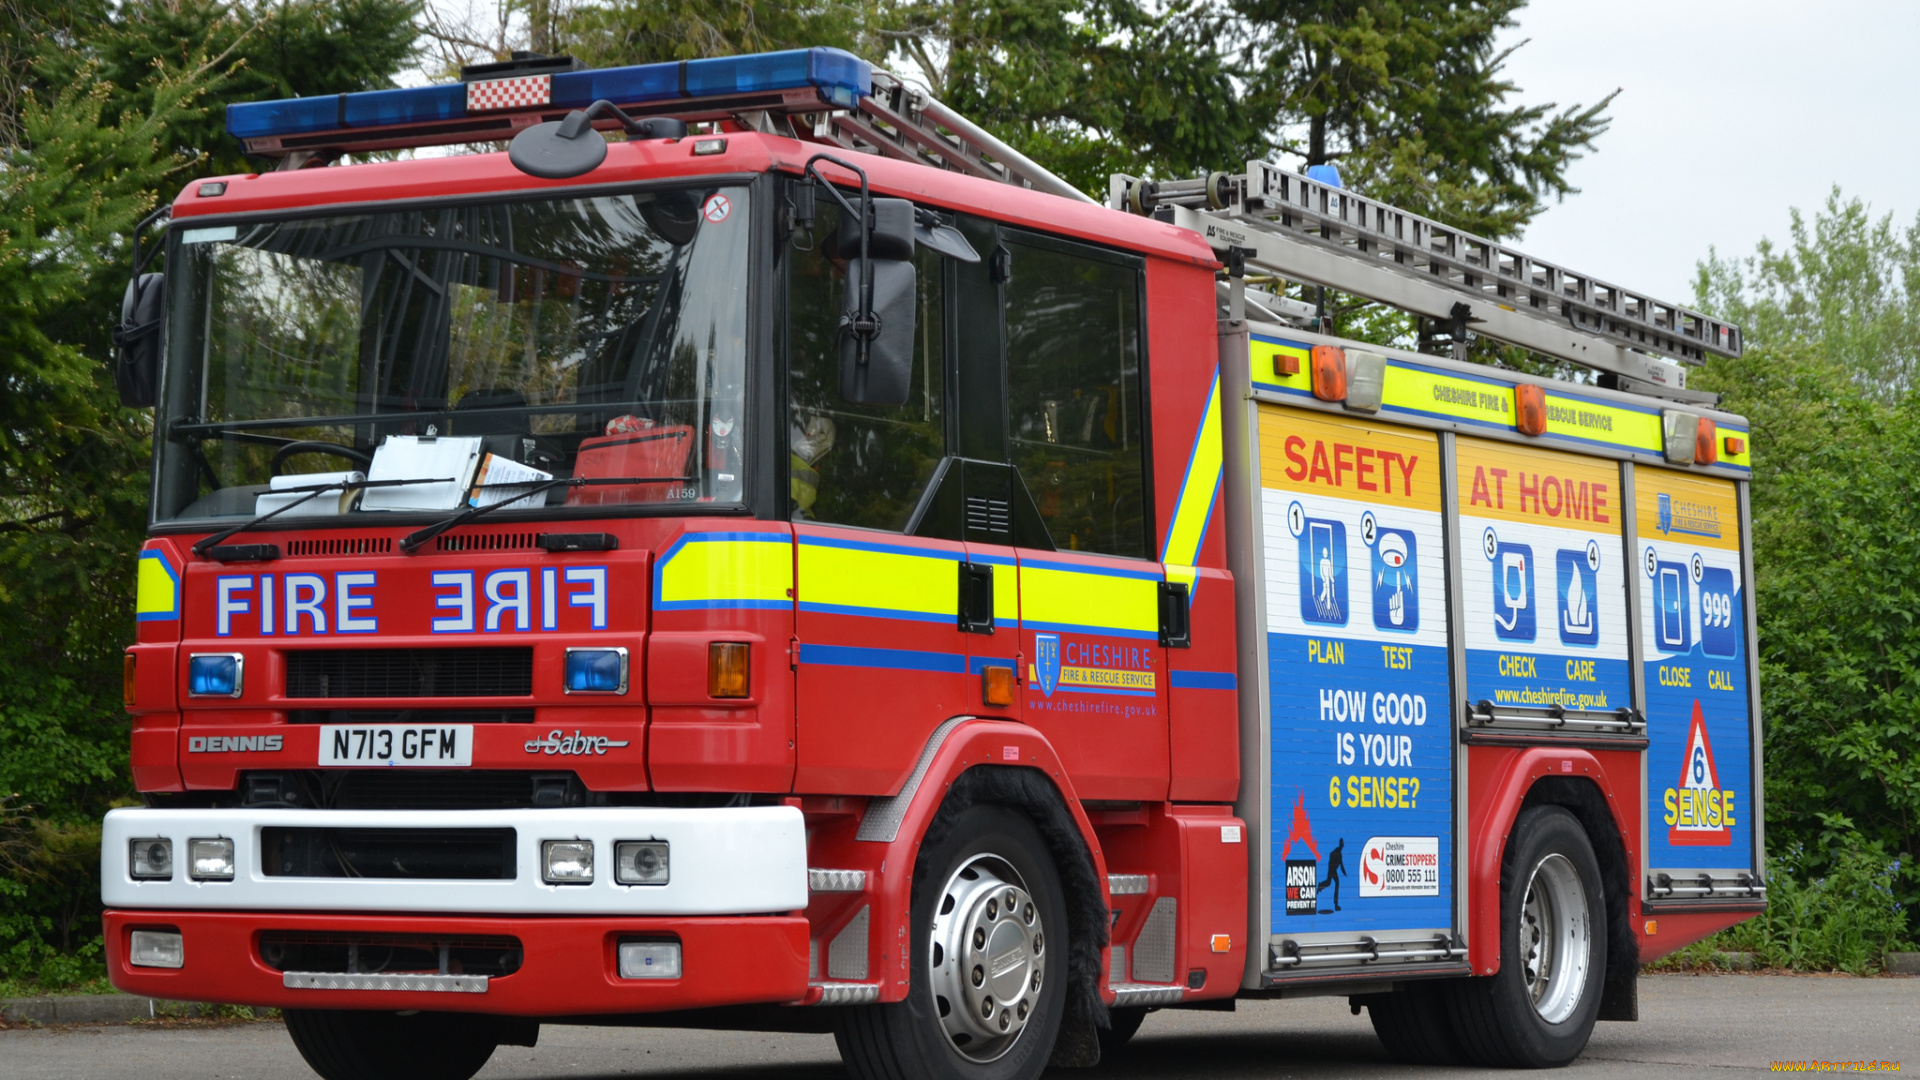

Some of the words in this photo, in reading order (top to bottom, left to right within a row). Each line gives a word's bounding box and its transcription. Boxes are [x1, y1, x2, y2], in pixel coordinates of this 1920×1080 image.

[1220, 234, 1243, 246] EQUIPMENT
[1433, 384, 1477, 408] CHESHIRE
[1479, 394, 1499, 410] FIRE
[1501, 397, 1508, 413] &
[1545, 405, 1576, 425] RESCUE
[1578, 411, 1612, 431] SERVICE
[1284, 435, 1418, 497] SAFETY
[667, 488, 696, 499] A159
[1470, 465, 1508, 509] AT
[1519, 472, 1610, 524] HOME
[1293, 509, 1299, 530] 1
[1673, 500, 1718, 520] CHESHIRE
[1365, 518, 1373, 539] 2
[1674, 517, 1683, 526] FIRE
[1688, 519, 1703, 529] RESCUE
[1703, 522, 1719, 531] SERVICE
[1487, 534, 1494, 554] 3
[1589, 546, 1596, 566] 4
[1648, 553, 1655, 572] 5
[1694, 559, 1700, 578] 6
[217, 570, 378, 637] FIRE
[1703, 591, 1731, 629] 999
[1066, 642, 1150, 669] CHESHIRE
[1308, 639, 1344, 664] PLAN
[1381, 645, 1413, 670] TEST
[1499, 654, 1537, 678] CHECK
[1566, 659, 1596, 682] CARE
[1659, 665, 1691, 687] CLOSE
[1063, 669, 1079, 681] FIRE
[1082, 672, 1088, 682] &
[1090, 671, 1120, 684] RESCUE
[1121, 673, 1153, 686] SERVICE
[1708, 669, 1734, 691] CALL
[1029, 699, 1156, 718] www.cheshirefire.gov.uk
[1320, 688, 1367, 722] HOW
[1372, 692, 1427, 726] GOOD
[1495, 686, 1607, 711] www.cheshirefire.gov.uk
[188, 735, 284, 753] DENNIS
[333, 729, 393, 760] N713
[401, 729, 456, 759] GFM
[544, 729, 609, 755] Sabre
[1336, 732, 1355, 765] IS
[1359, 733, 1412, 767] YOUR
[1693, 746, 1705, 784] 6
[1329, 776, 1341, 808] 6
[1347, 775, 1420, 809] SENSE?
[1663, 787, 1736, 827] SENSE
[1385, 842, 1404, 851] Cheshire
[1385, 854, 1436, 866] CRIMESTOPPERS
[1287, 866, 1315, 886] ARSON
[1386, 869, 1405, 883] 0800
[1408, 869, 1421, 883] 555
[1424, 869, 1436, 882] 111
[1287, 887, 1299, 899] WE
[1300, 887, 1315, 899] CAN
[1287, 901, 1310, 909] PREVENT
